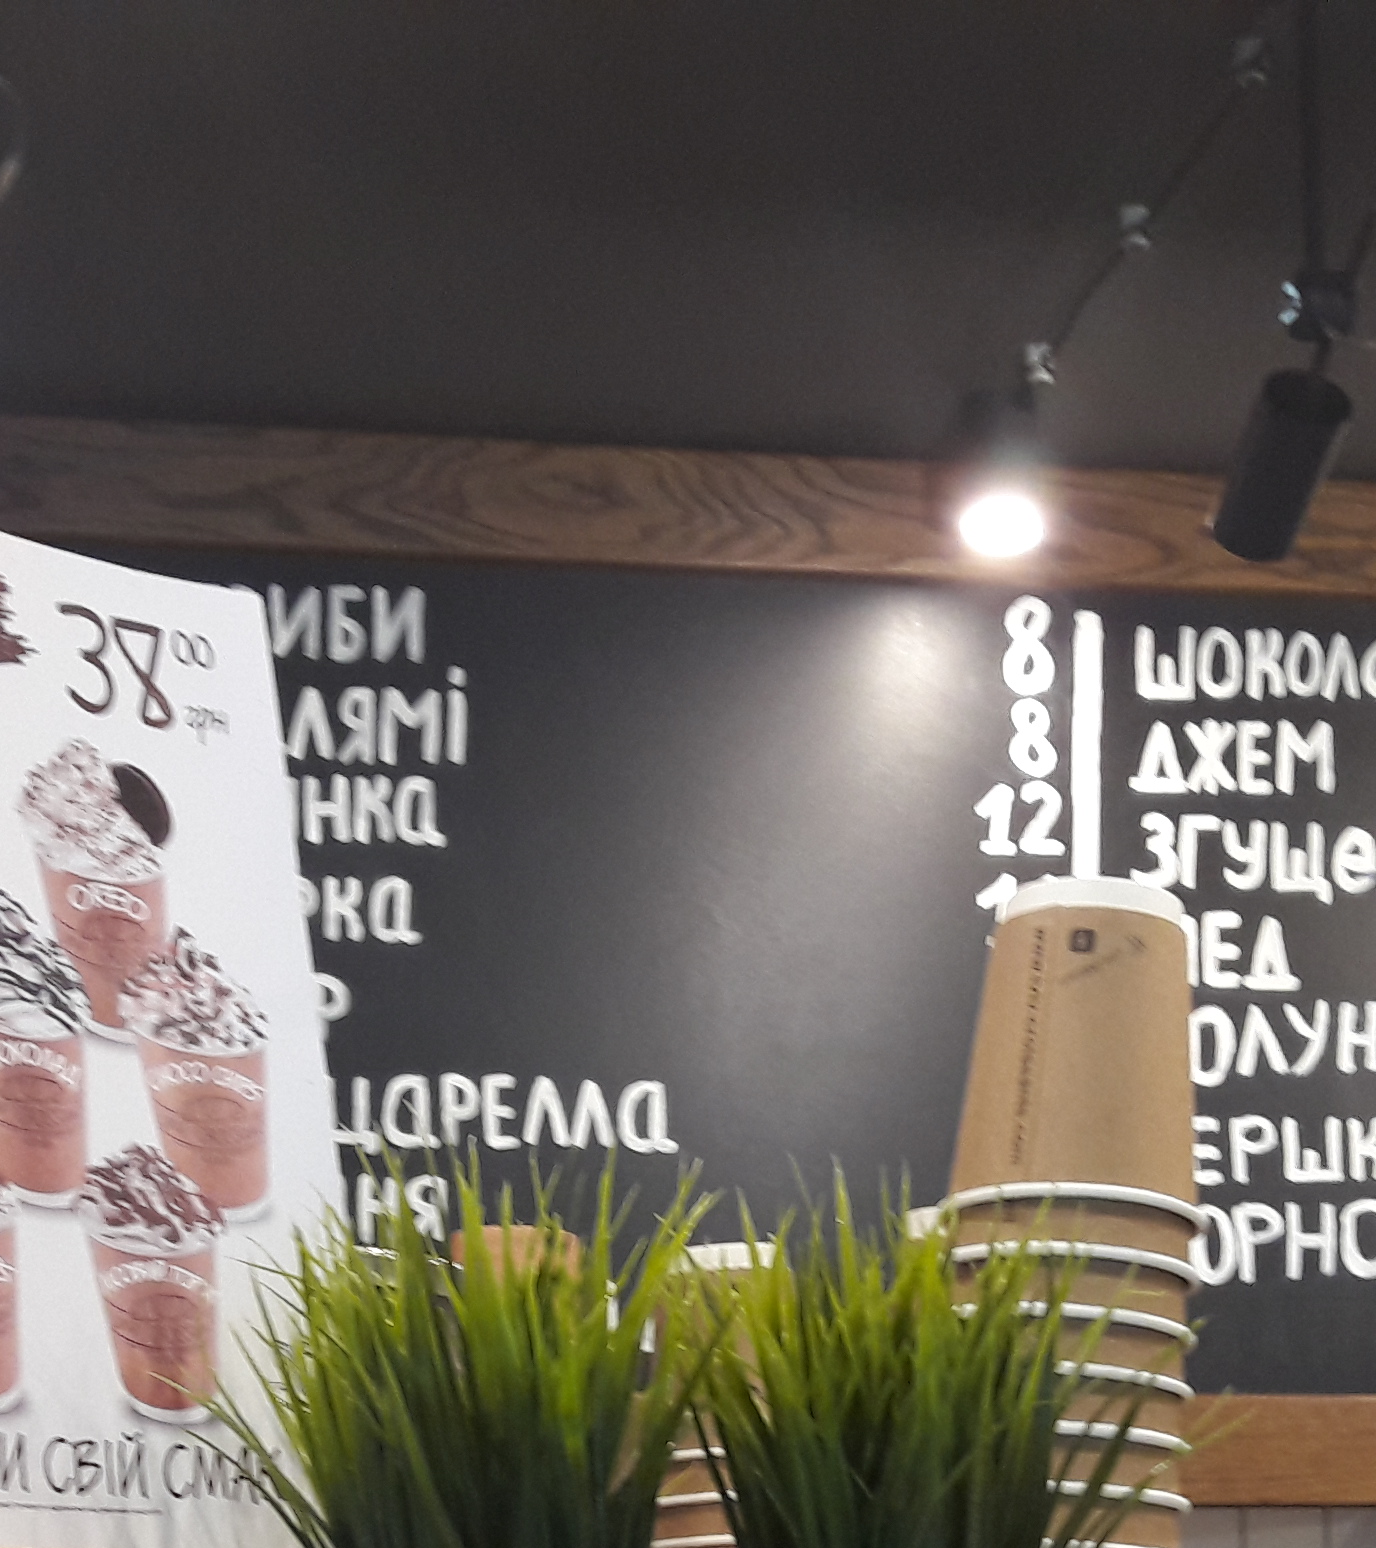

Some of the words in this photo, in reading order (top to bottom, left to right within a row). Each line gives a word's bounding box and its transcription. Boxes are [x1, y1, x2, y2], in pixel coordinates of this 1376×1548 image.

[56, 603, 173, 730] 38
[1002, 594, 1056, 696] 8
[283, 664, 470, 766] ЛЯМІ
[1008, 696, 1059, 779] 8
[1127, 717, 1337, 797] ДЖЕМ
[292, 772, 448, 849] НКА
[974, 779, 1067, 857] 12
[340, 1170, 450, 1245] НЯ
[41, 1431, 151, 1500] СВІЙ
